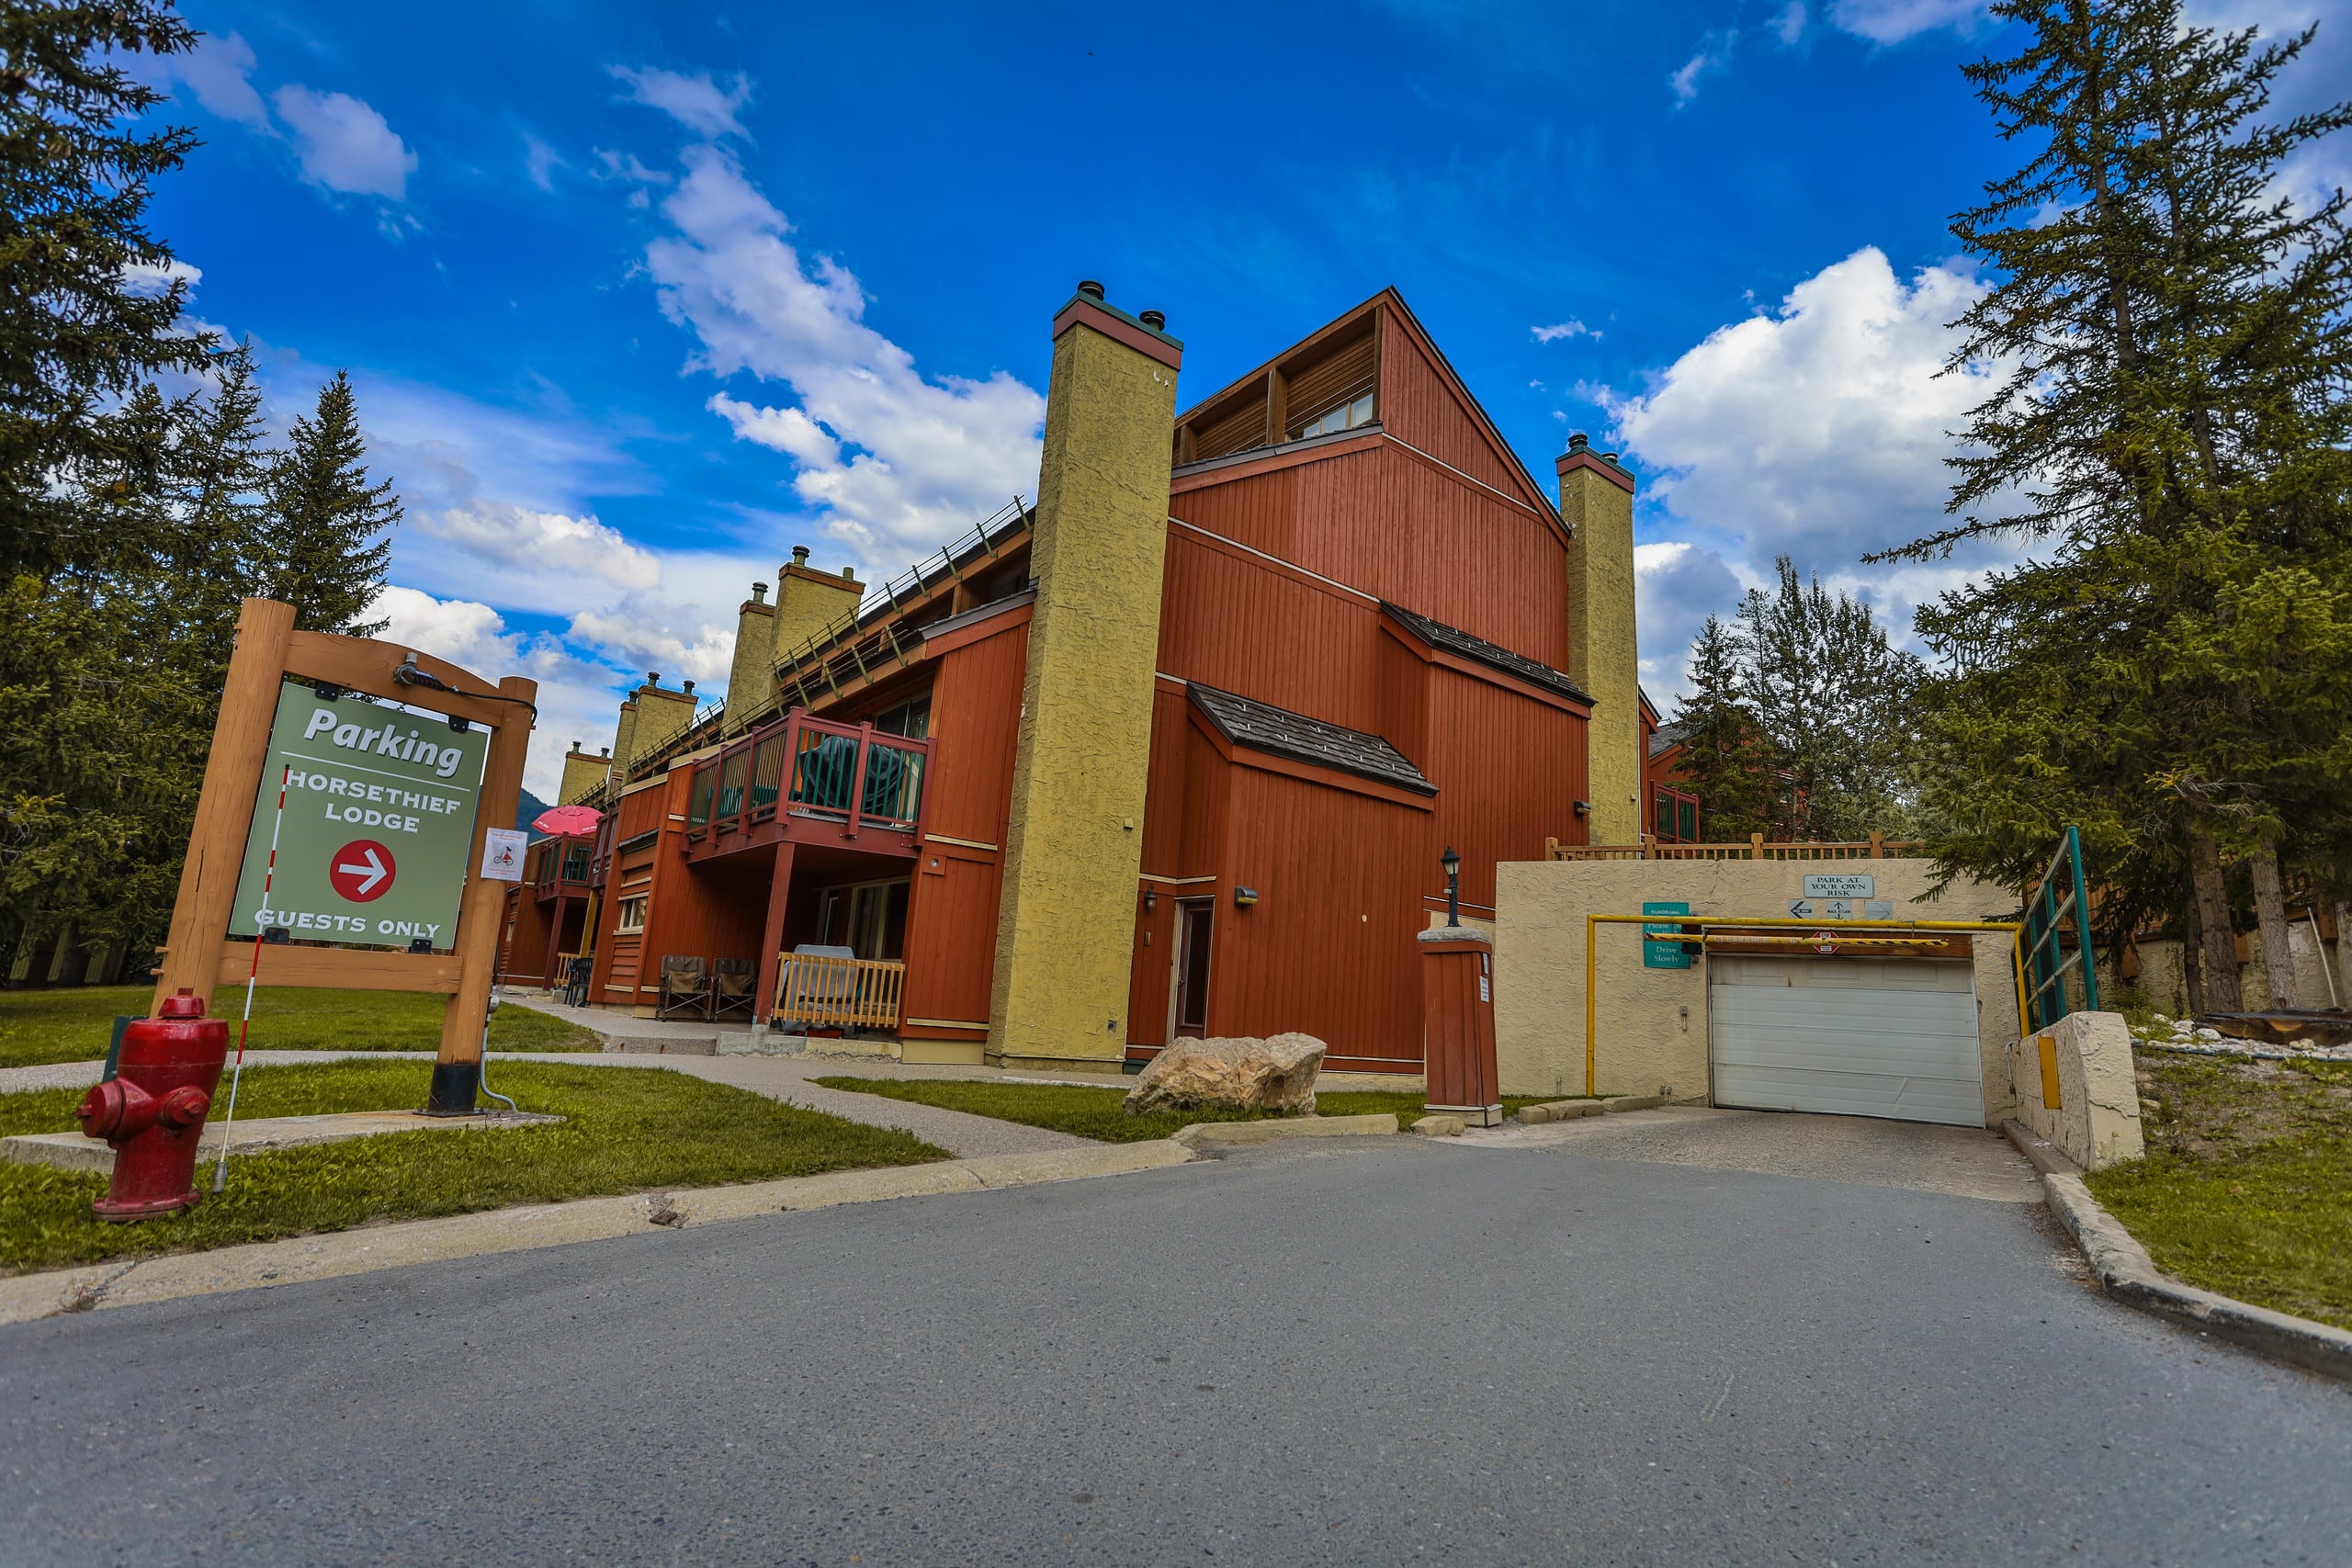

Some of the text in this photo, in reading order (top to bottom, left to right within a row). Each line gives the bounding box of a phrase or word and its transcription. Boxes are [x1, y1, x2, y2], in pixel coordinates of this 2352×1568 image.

[303, 708, 463, 778] Parking
[287, 769, 461, 815] HORSETHIEF
[324, 802, 420, 834] LODGE
[254, 908, 441, 939] GUESTS ONLY
[1654, 954, 1679, 964] Slowly
[1656, 945, 1678, 953] Drive
